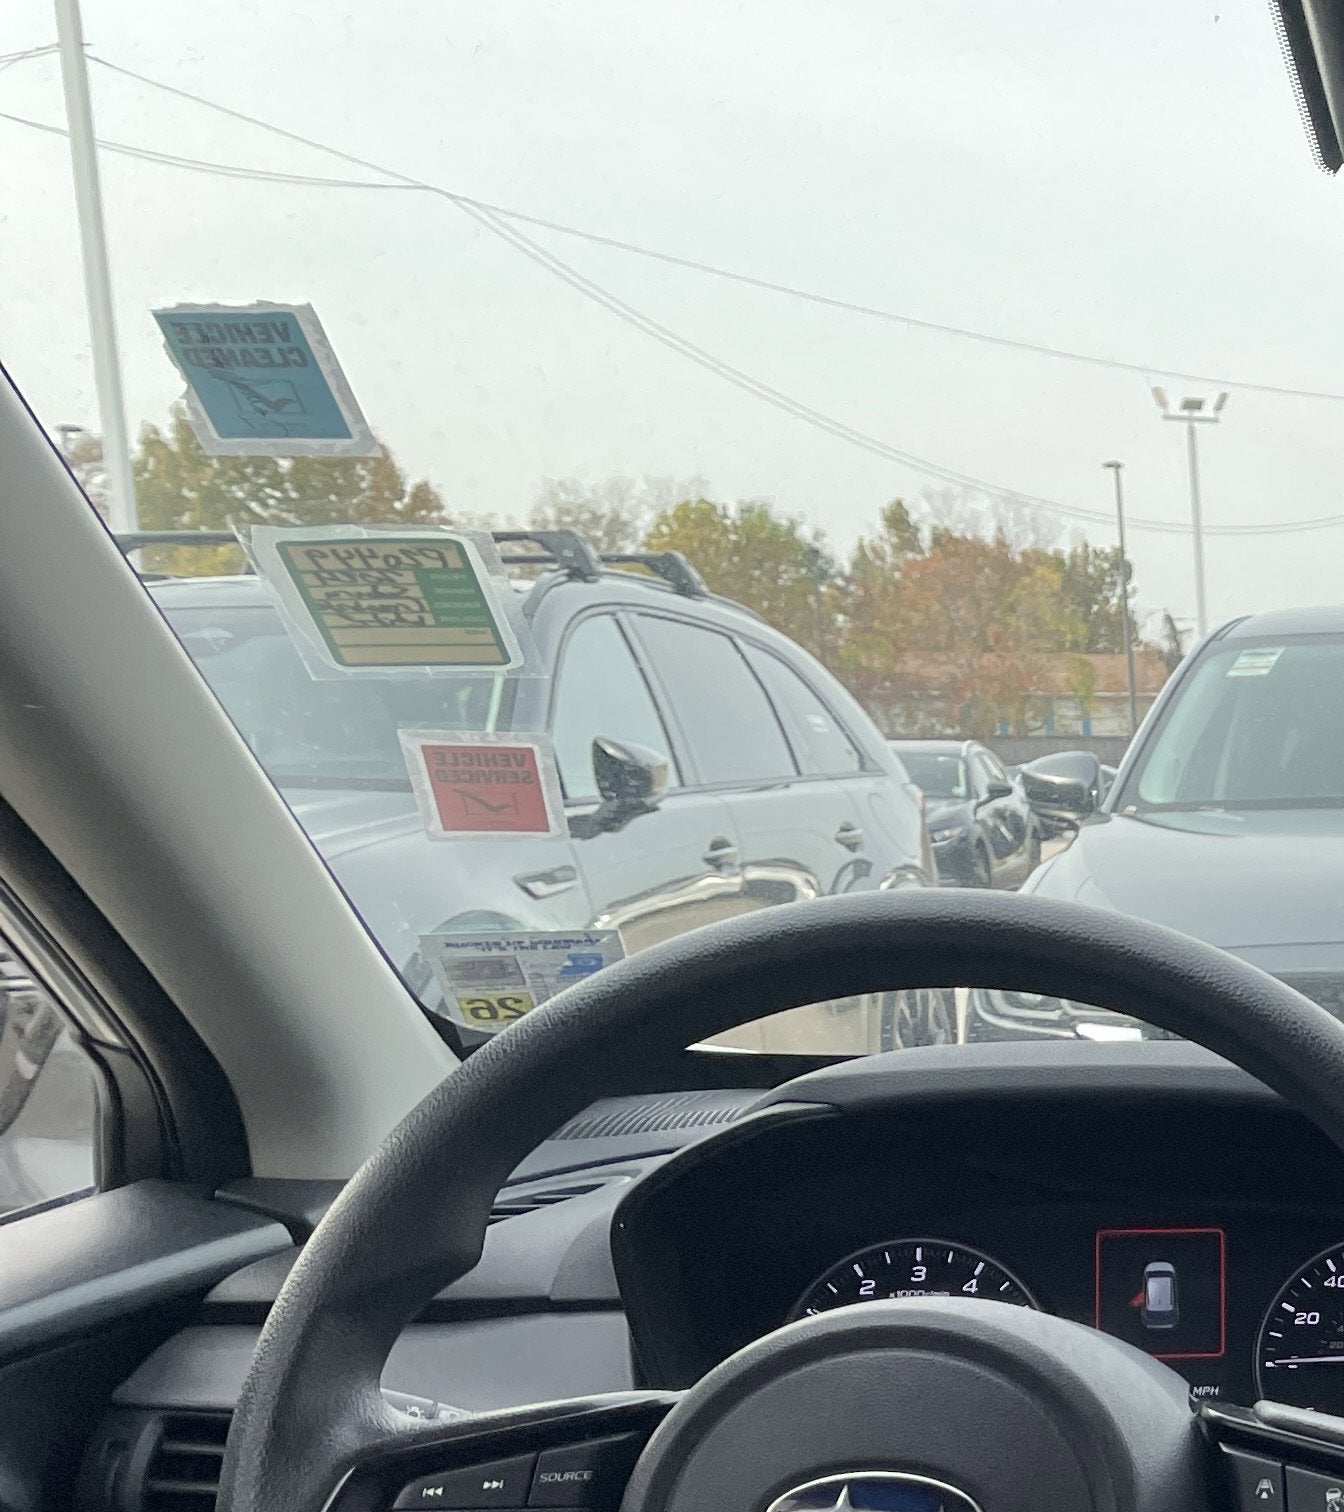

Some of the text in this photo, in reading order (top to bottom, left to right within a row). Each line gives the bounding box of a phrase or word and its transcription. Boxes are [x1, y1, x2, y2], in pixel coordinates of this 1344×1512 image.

[910, 1266, 927, 1281] 3
[859, 1279, 876, 1295] 2
[962, 1279, 978, 1293] 4
[1294, 1312, 1320, 1325] 20
[1192, 1386, 1220, 1396] MPH
[539, 1470, 593, 1483] SOURCE
